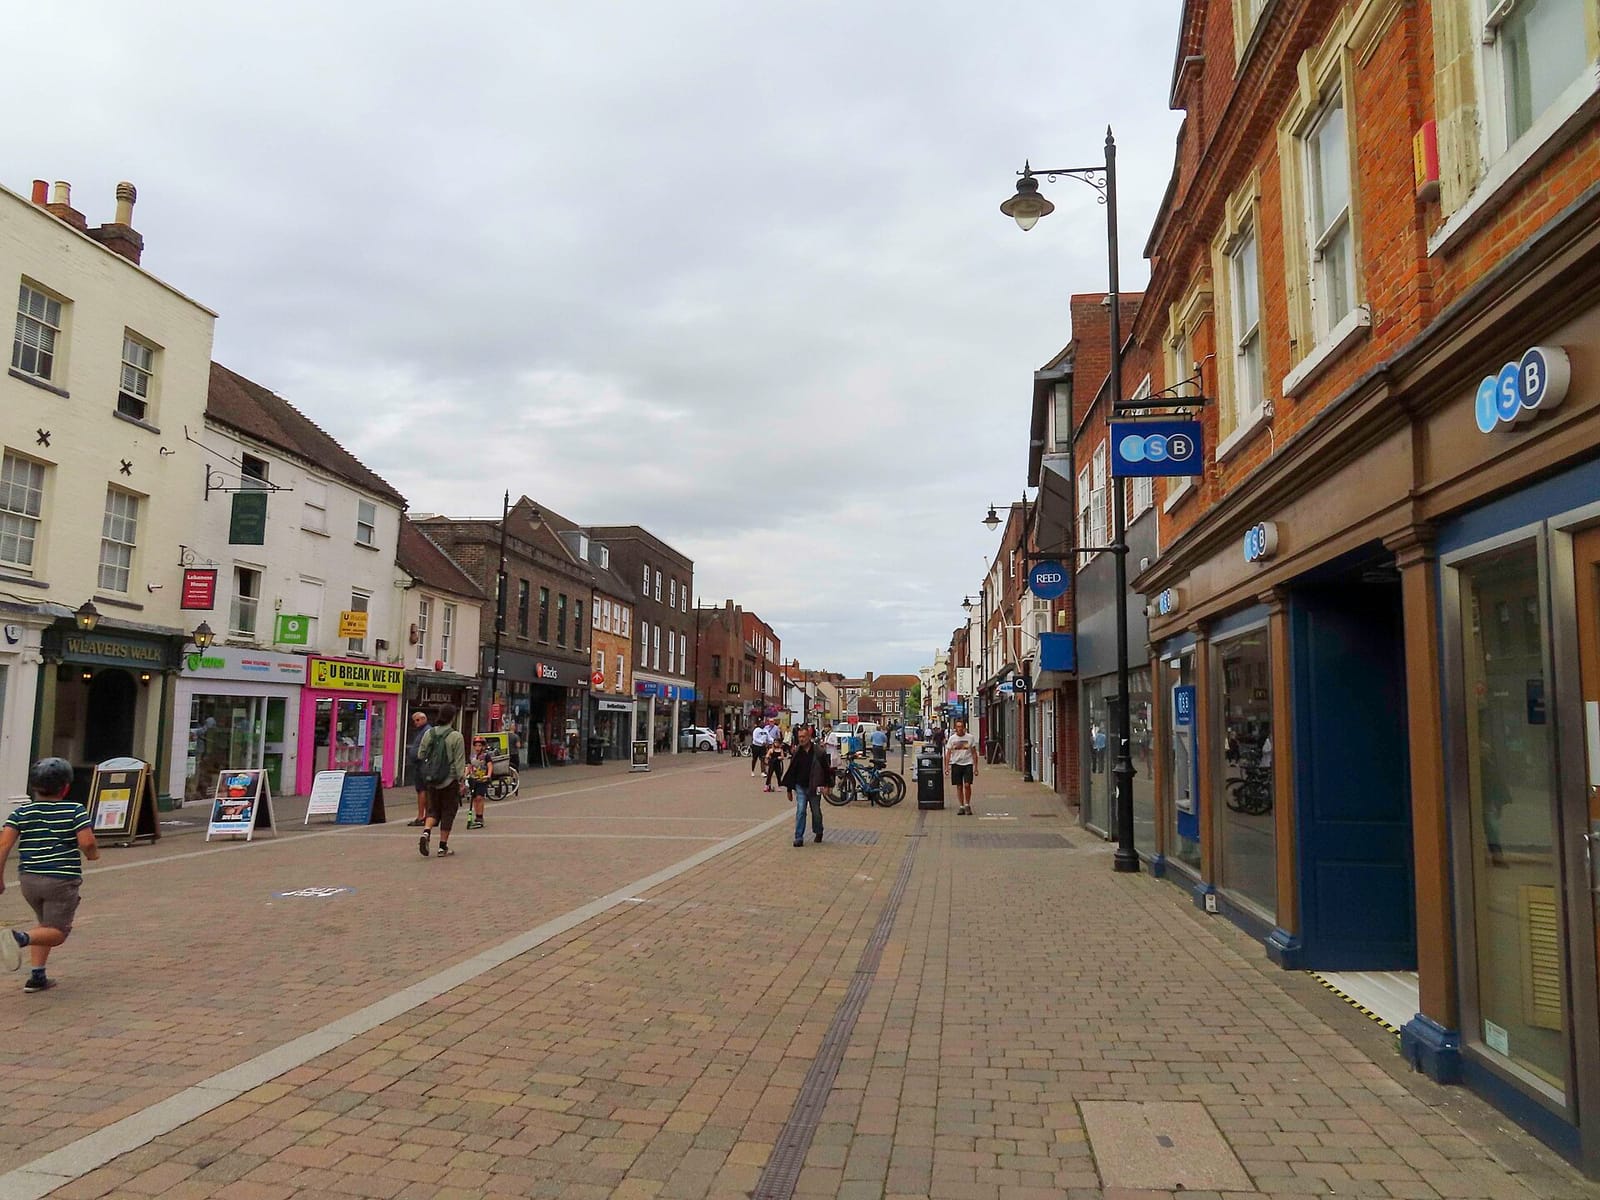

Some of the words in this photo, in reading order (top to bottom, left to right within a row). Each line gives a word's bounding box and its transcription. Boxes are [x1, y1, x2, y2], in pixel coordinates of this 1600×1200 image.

[1478, 355, 1544, 426] TSB
[1125, 437, 1190, 458] TSB
[1036, 573, 1062, 583] REED
[68, 639, 128, 658] WEAVERS
[131, 646, 160, 661] WALK
[330, 664, 337, 678] U
[339, 665, 370, 681] BREAK
[372, 669, 386, 682] WE
[388, 670, 401, 684] FIX
[542, 664, 558, 679] Blacks
